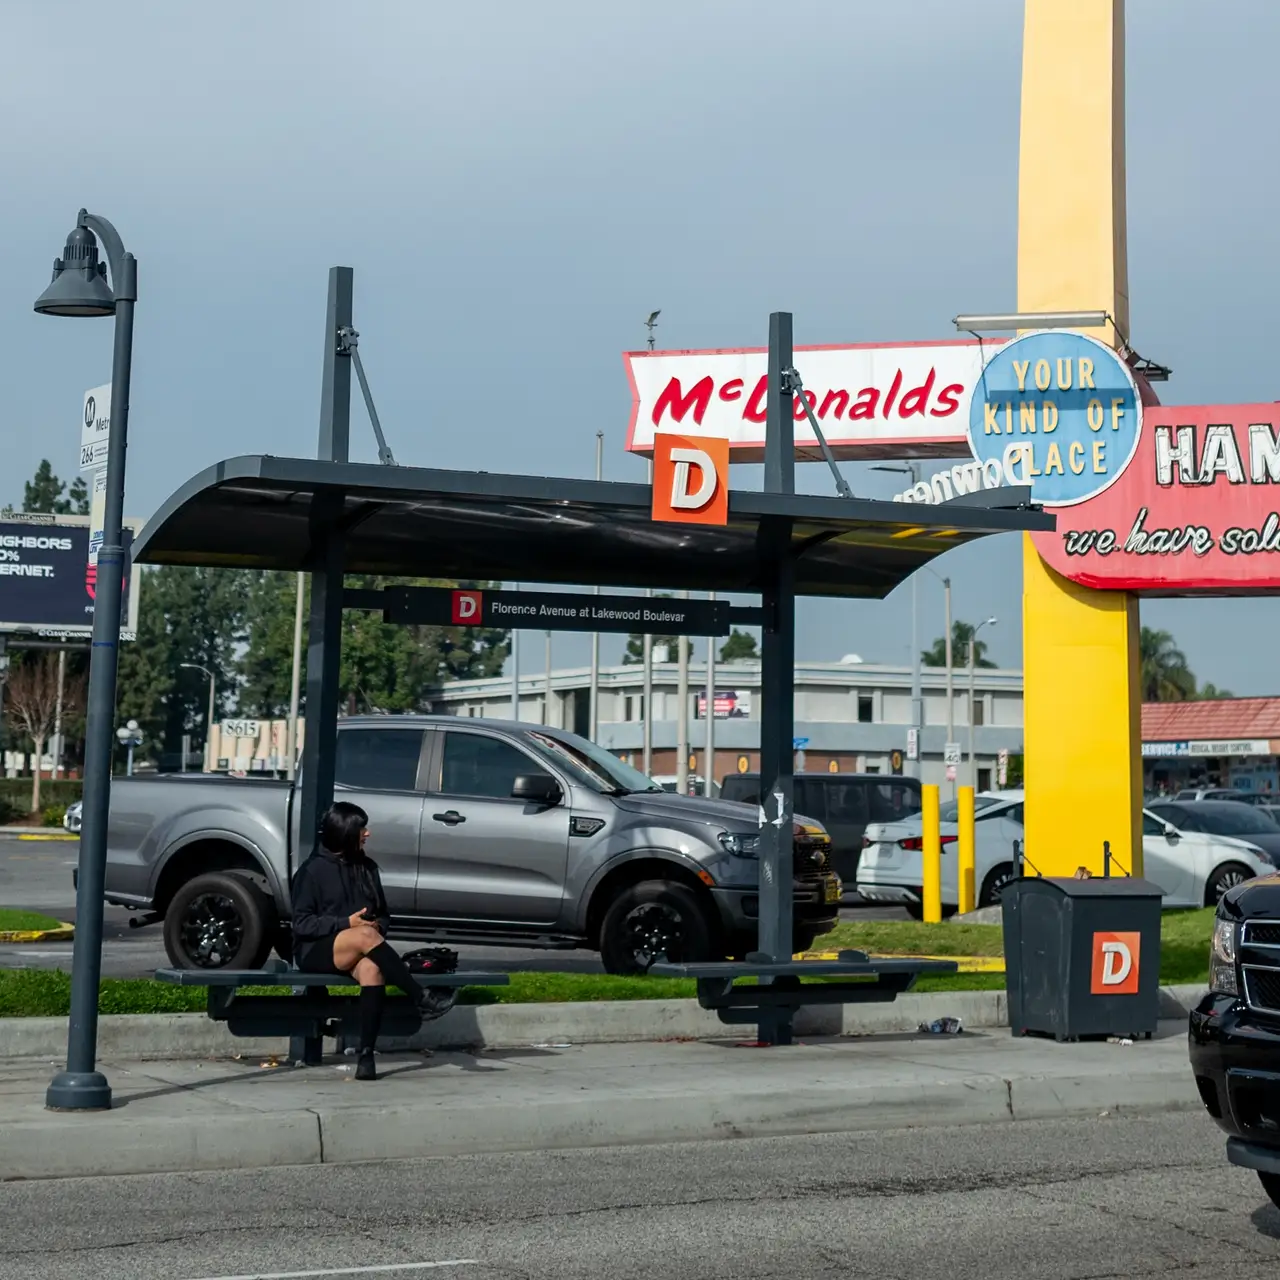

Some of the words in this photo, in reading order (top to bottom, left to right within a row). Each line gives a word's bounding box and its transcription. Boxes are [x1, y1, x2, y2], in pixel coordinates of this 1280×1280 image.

[1012, 358, 1095, 392] YOUR
[96, 418, 110, 432] Metr
[984, 401, 1059, 434] KIND
[1087, 397, 1125, 432] OF
[81, 446, 93, 465] 266
[669, 448, 717, 510] D
[1062, 526, 1117, 557] we
[1123, 506, 1214, 557] have
[459, 596, 477, 618] D
[491, 602, 537, 615] Florence
[539, 604, 577, 617] Avenue
[579, 608, 590, 618] at
[592, 608, 641, 621] Lakewood
[643, 609, 685, 622] Boulevar
[226, 721, 256, 735] 8615
[1101, 941, 1132, 986] D
